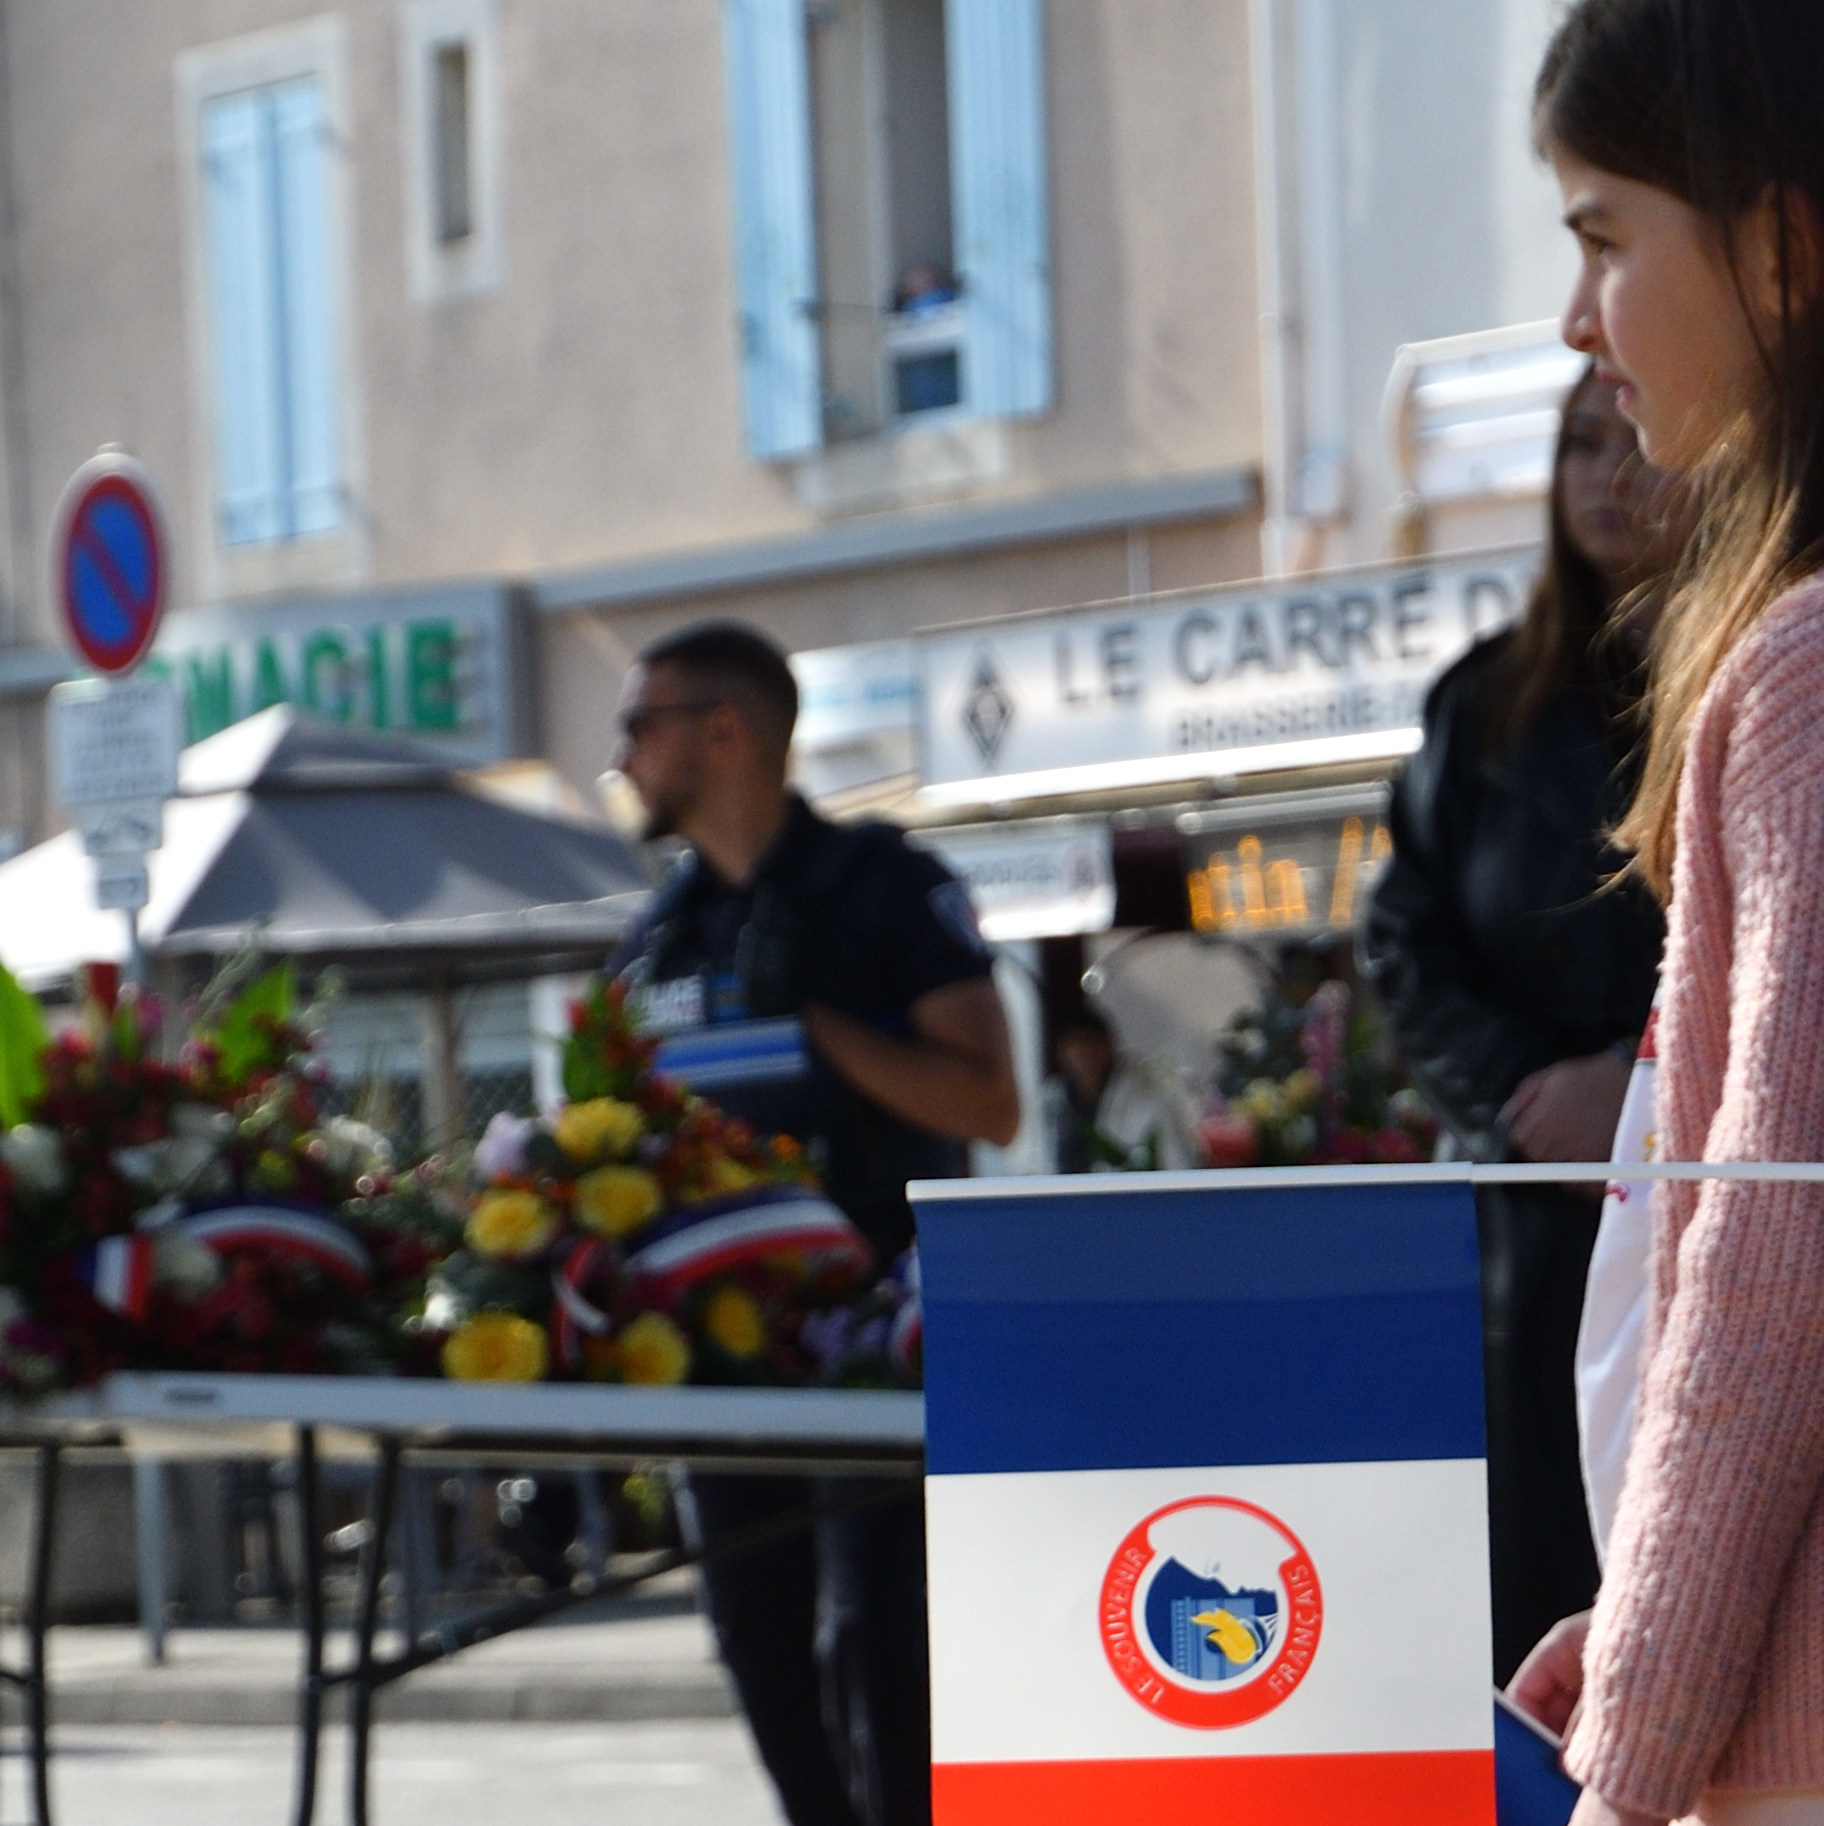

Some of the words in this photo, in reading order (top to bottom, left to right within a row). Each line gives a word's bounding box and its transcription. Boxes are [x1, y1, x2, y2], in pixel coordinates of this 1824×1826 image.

[148, 616, 460, 744] MACIE
[1053, 620, 1145, 702] LE
[1174, 568, 1429, 687] CARRE
[1105, 1547, 1149, 1674] SOUVENIR
[1267, 1563, 1321, 1696] FRANÇAIS
[1134, 1677, 1165, 1704] LE
